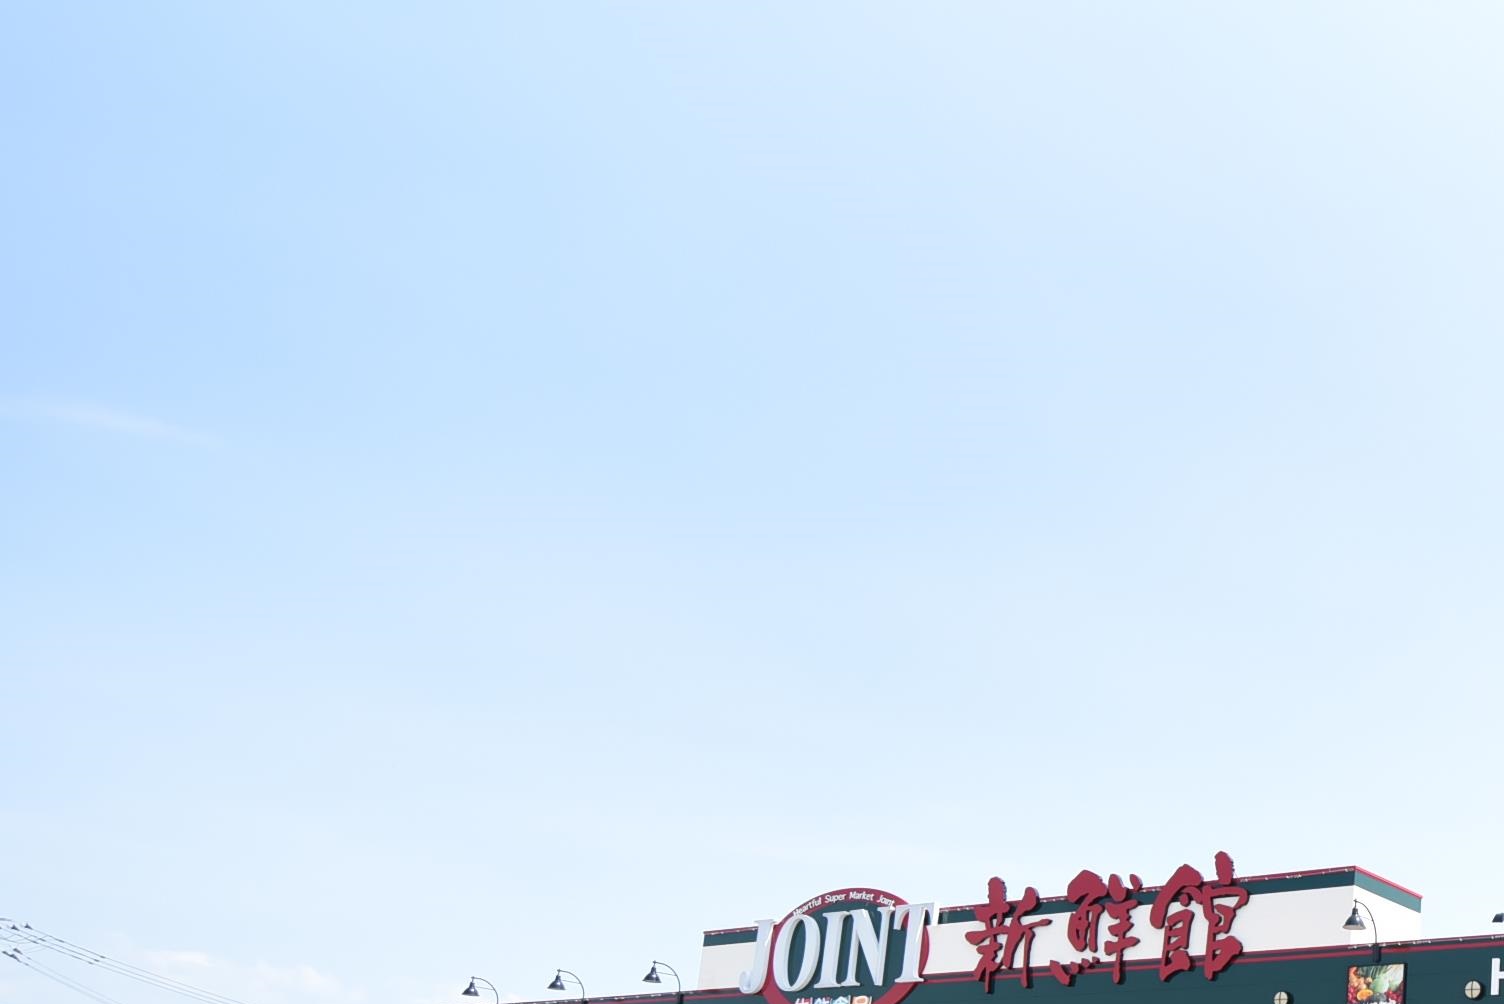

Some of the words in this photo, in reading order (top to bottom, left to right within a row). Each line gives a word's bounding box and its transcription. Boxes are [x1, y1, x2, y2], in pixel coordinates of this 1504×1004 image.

[738, 902, 935, 995] JOINT
[792, 897, 822, 917] Heartful
[825, 893, 847, 904] Super
[850, 891, 874, 901] Market
[878, 895, 896, 908] Joint
[965, 851, 1250, 994] 新鮮館
